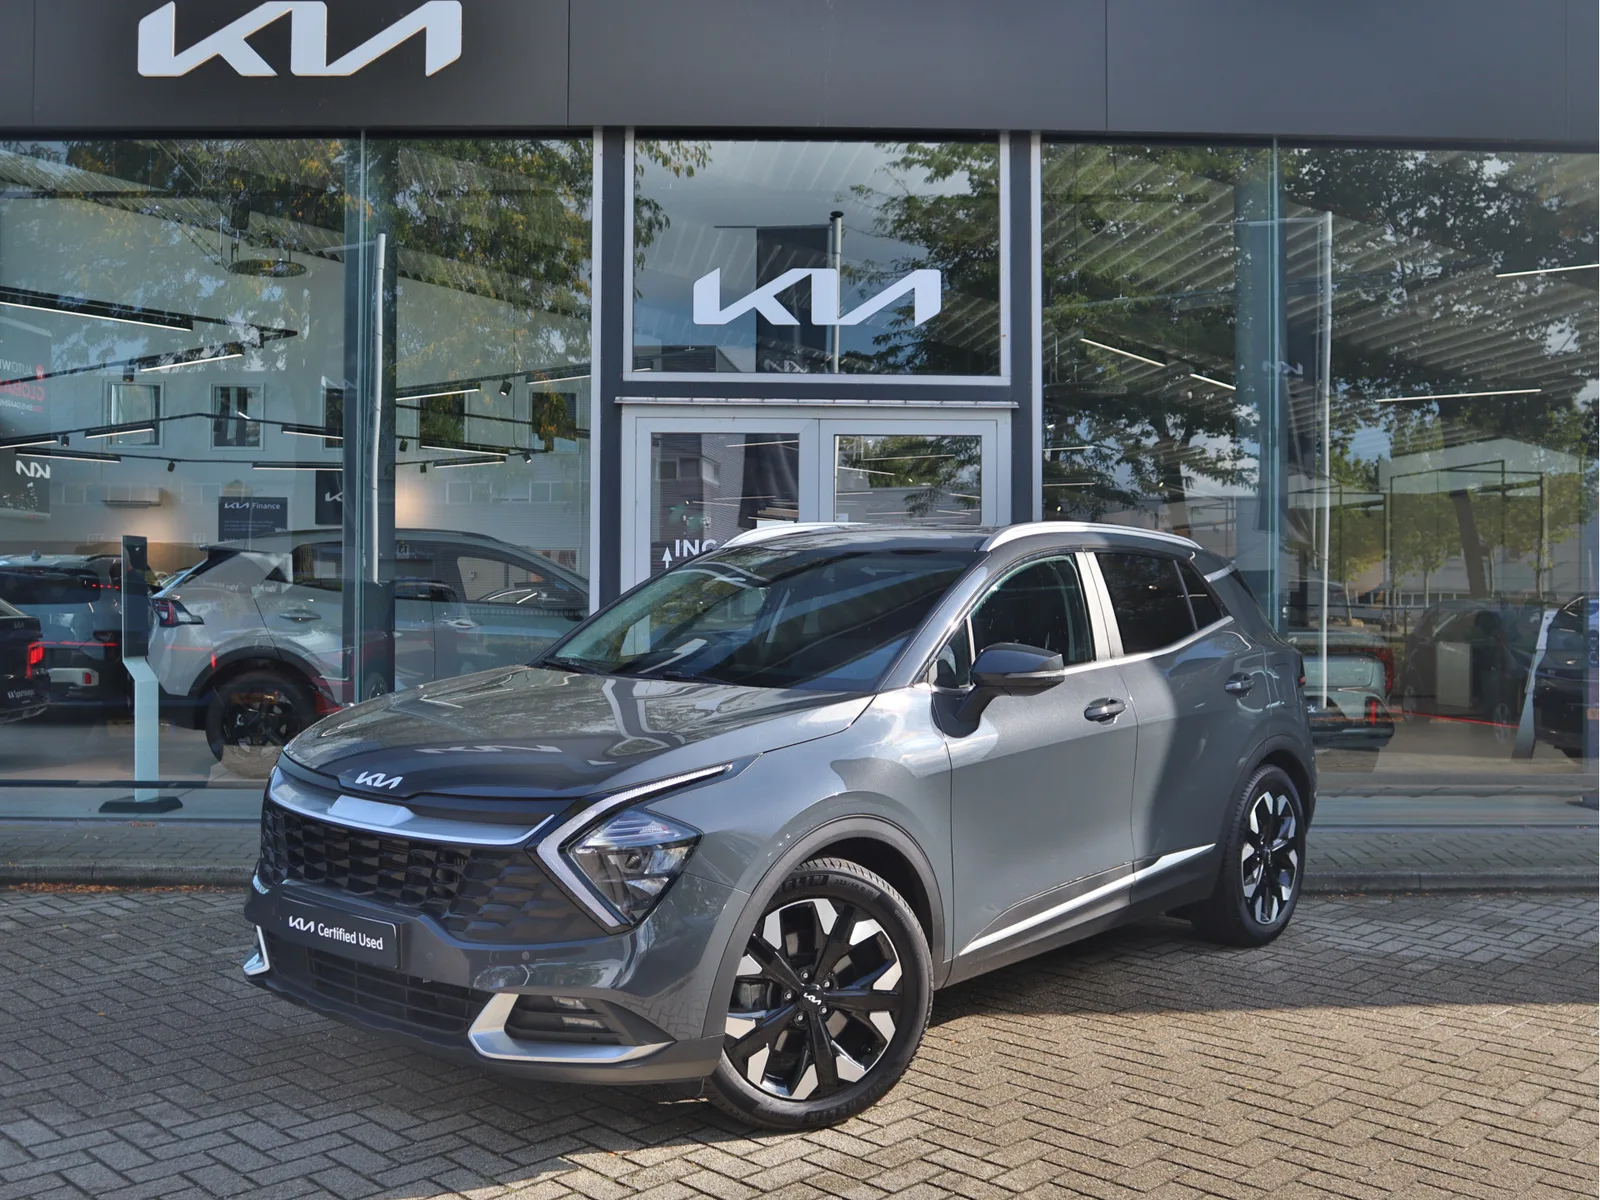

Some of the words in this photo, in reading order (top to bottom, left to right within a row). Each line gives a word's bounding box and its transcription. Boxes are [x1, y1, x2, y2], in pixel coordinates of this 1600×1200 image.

[138, 0, 462, 77] KIA
[693, 267, 942, 327] KIA
[252, 502, 281, 510] Finance
[355, 771, 403, 789] KIA
[289, 915, 315, 933] KIA
[317, 923, 357, 945] Certified
[359, 932, 384, 950] Used
